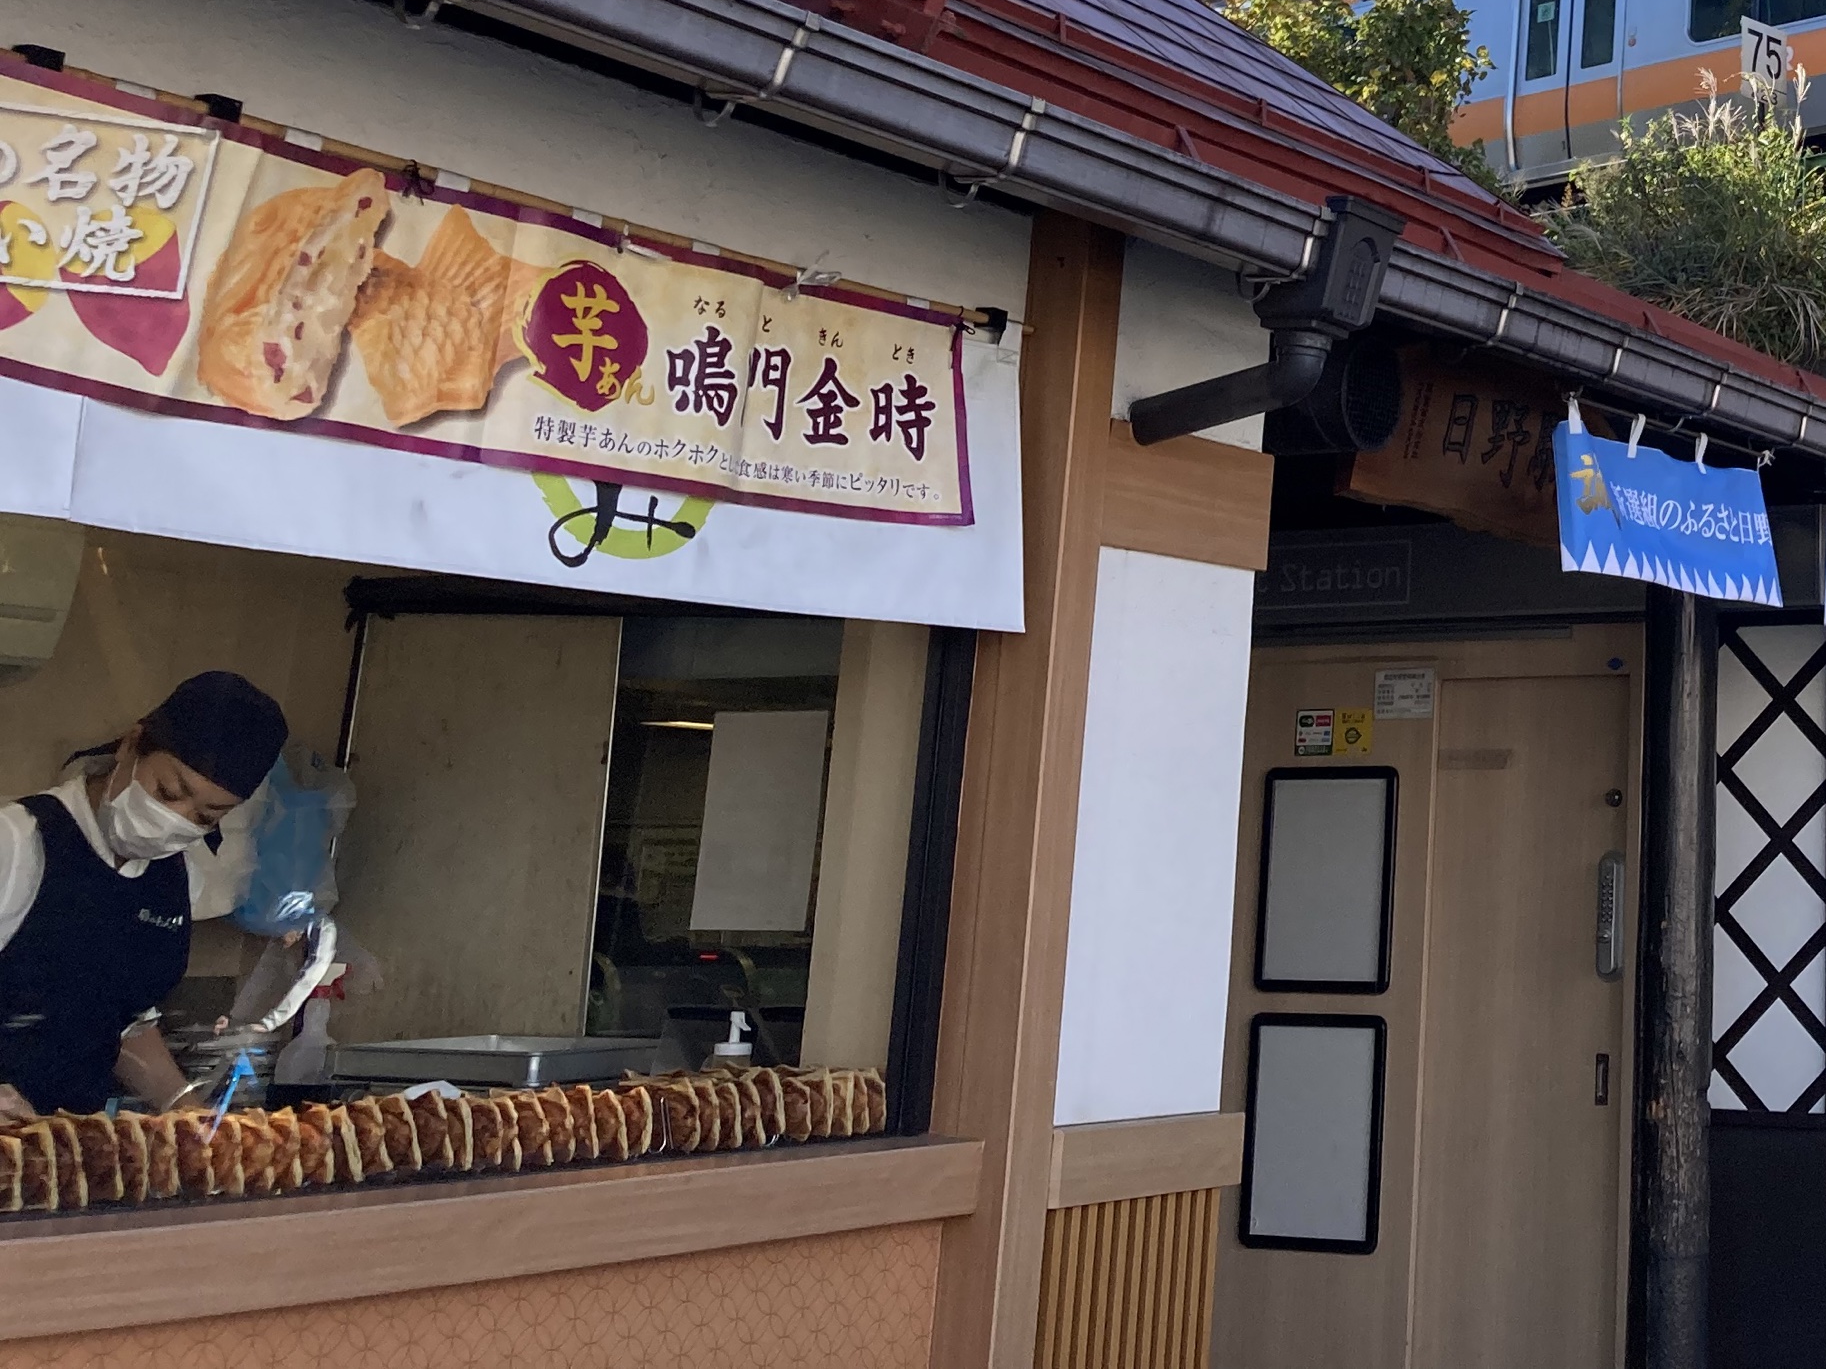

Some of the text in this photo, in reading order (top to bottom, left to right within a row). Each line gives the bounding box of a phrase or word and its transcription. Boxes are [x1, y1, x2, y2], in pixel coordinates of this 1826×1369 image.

[1747, 27, 1782, 80] 75
[692, 295, 916, 365] なる と きん とき
[667, 327, 936, 461] 鳴門金時
[1280, 560, 1401, 592] Station
